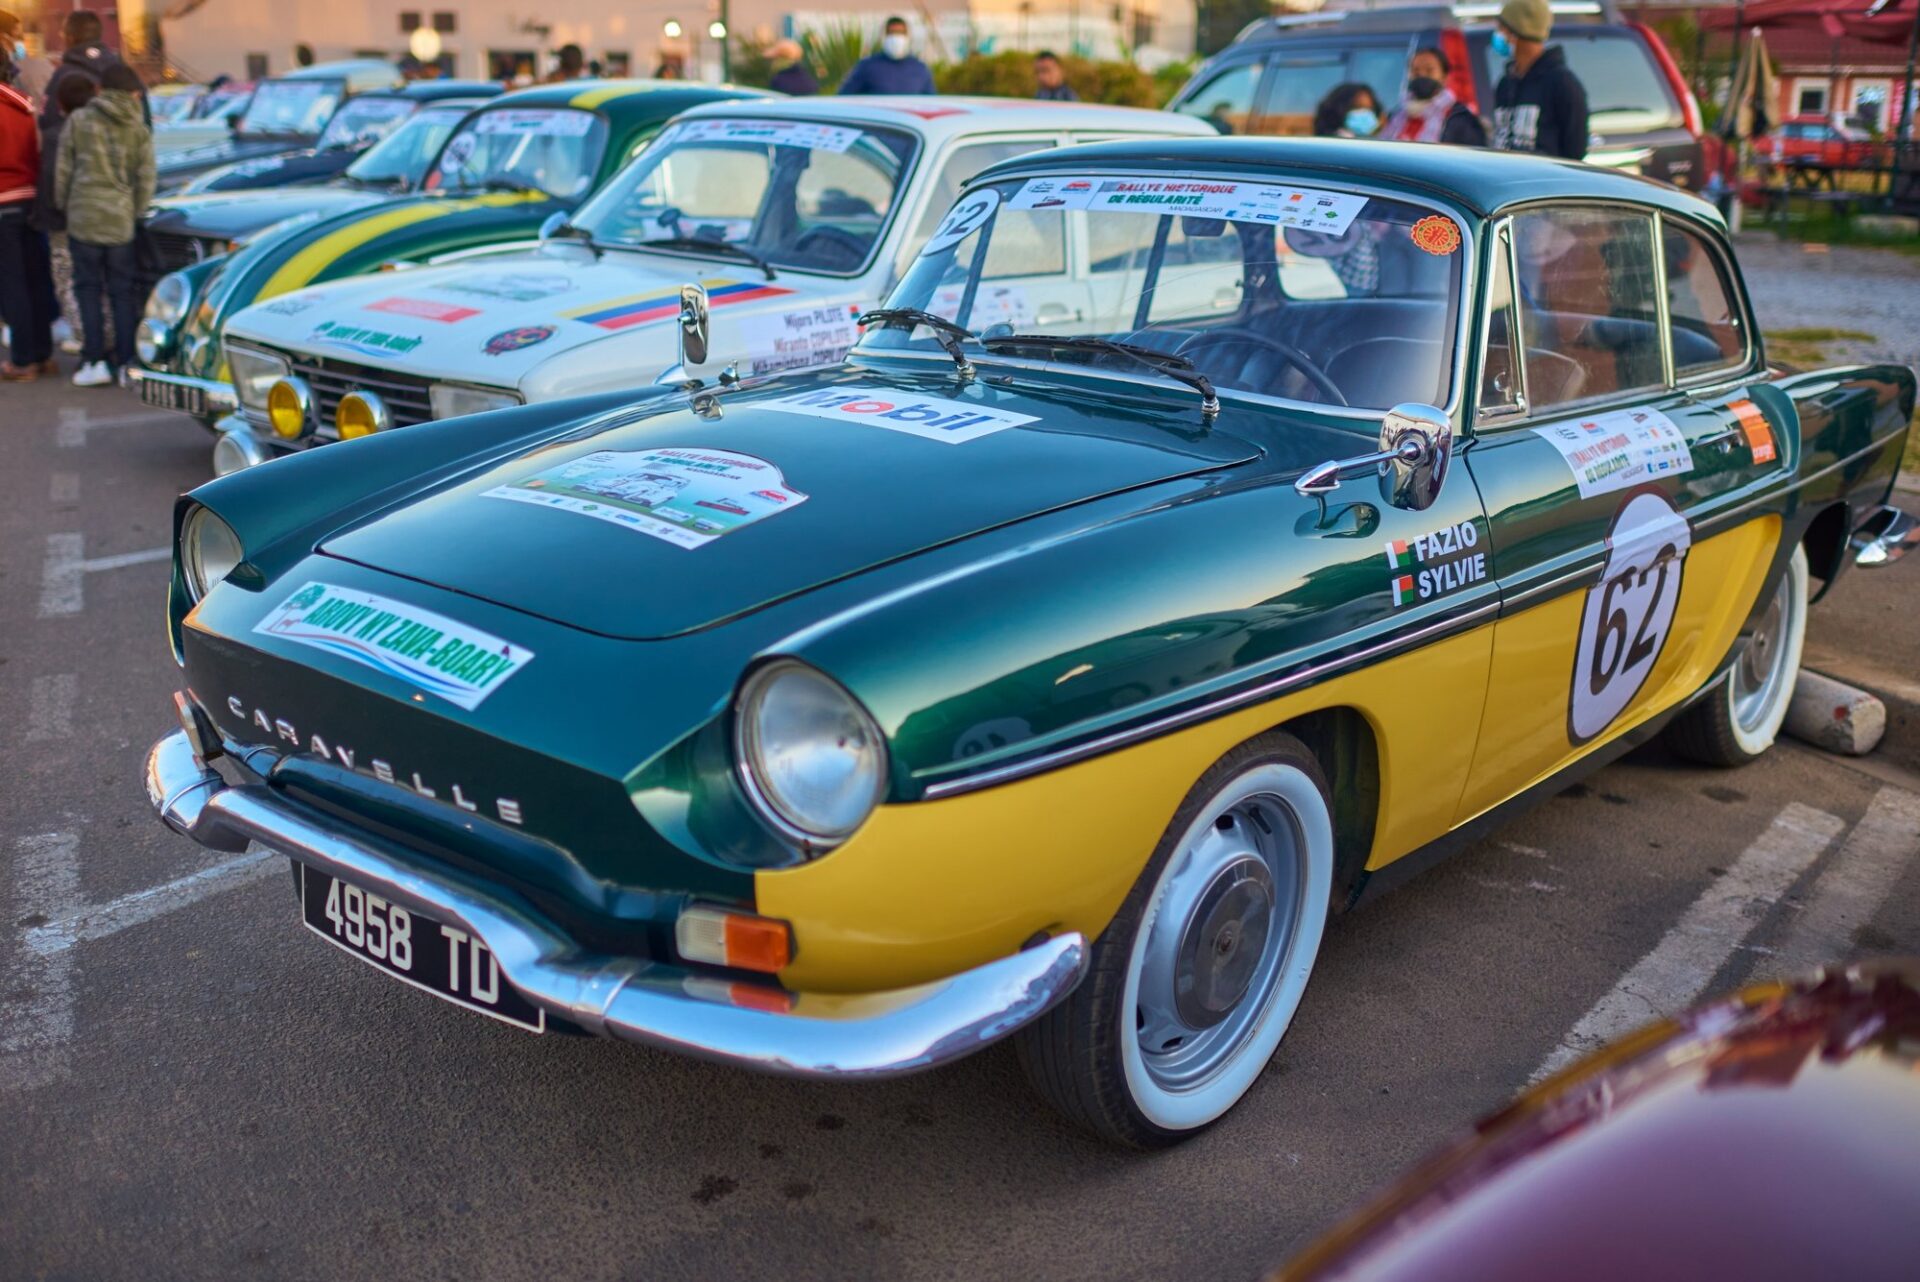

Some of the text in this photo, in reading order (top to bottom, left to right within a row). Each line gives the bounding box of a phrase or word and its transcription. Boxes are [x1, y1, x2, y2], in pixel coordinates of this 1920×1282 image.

[1107, 192, 1204, 205] DE RÉGULARITÉ
[1116, 182, 1238, 194] RALLYE HISTORIQUE
[780, 391, 996, 431] Mobil
[1413, 521, 1478, 562] FAZIO
[1418, 553, 1486, 598] SYLVIE
[1590, 543, 1677, 696] 62
[302, 597, 516, 689] AROVY NY ZAVA-BOARY
[227, 696, 523, 824] CARAVELLE
[325, 877, 499, 1005] 4958 TD
